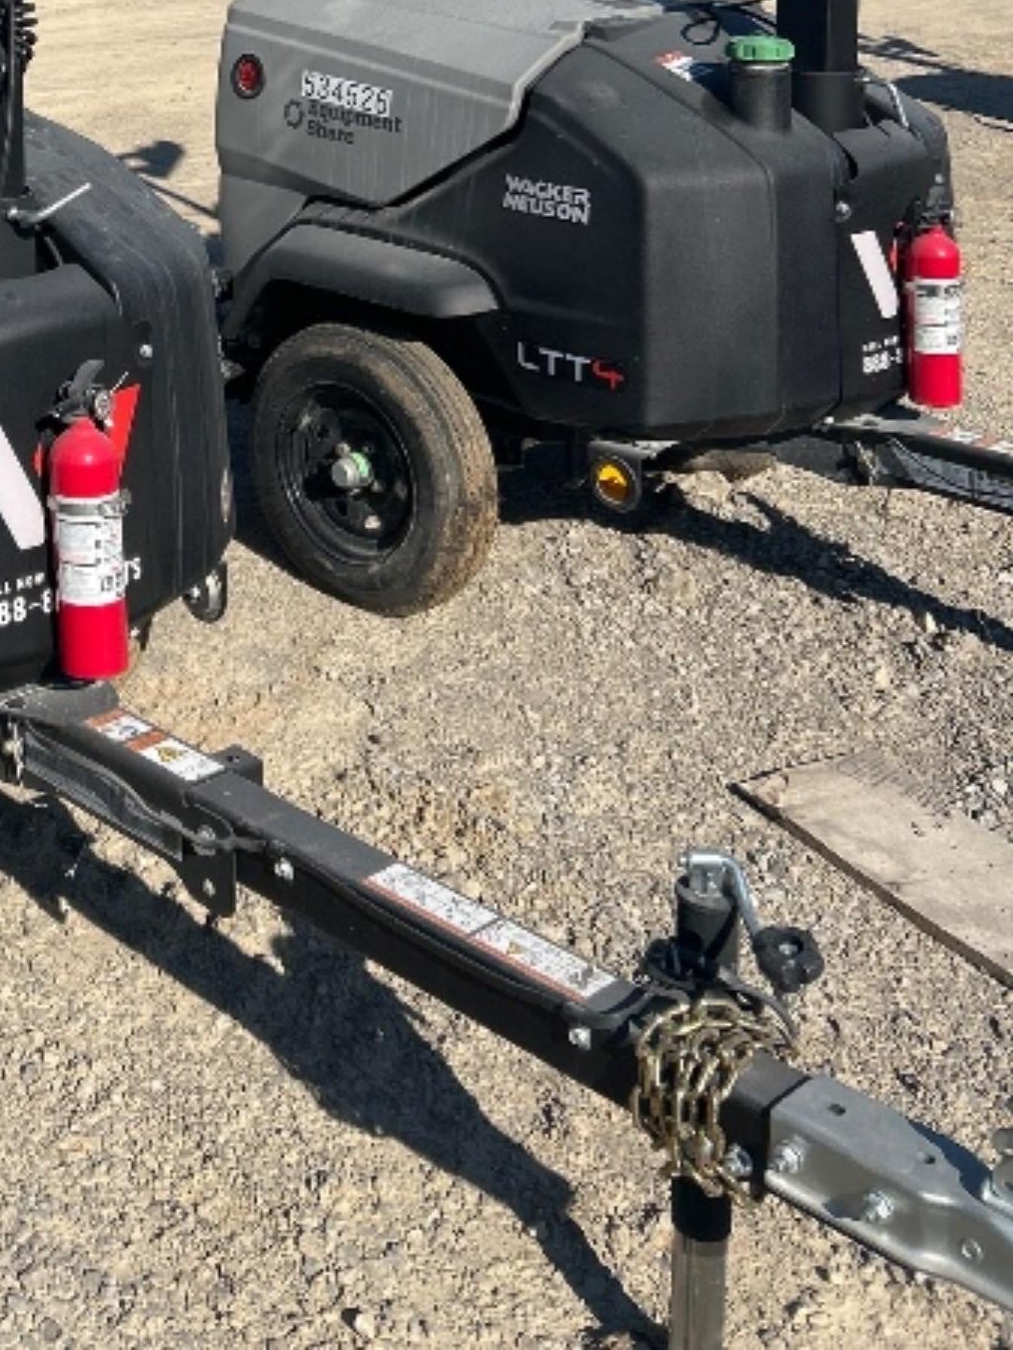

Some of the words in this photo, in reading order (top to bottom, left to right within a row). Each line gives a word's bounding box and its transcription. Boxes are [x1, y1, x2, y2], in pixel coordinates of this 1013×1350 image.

[506, 173, 590, 205] WACKER
[502, 192, 591, 225] NEUSON
[517, 341, 625, 391] LTT4
